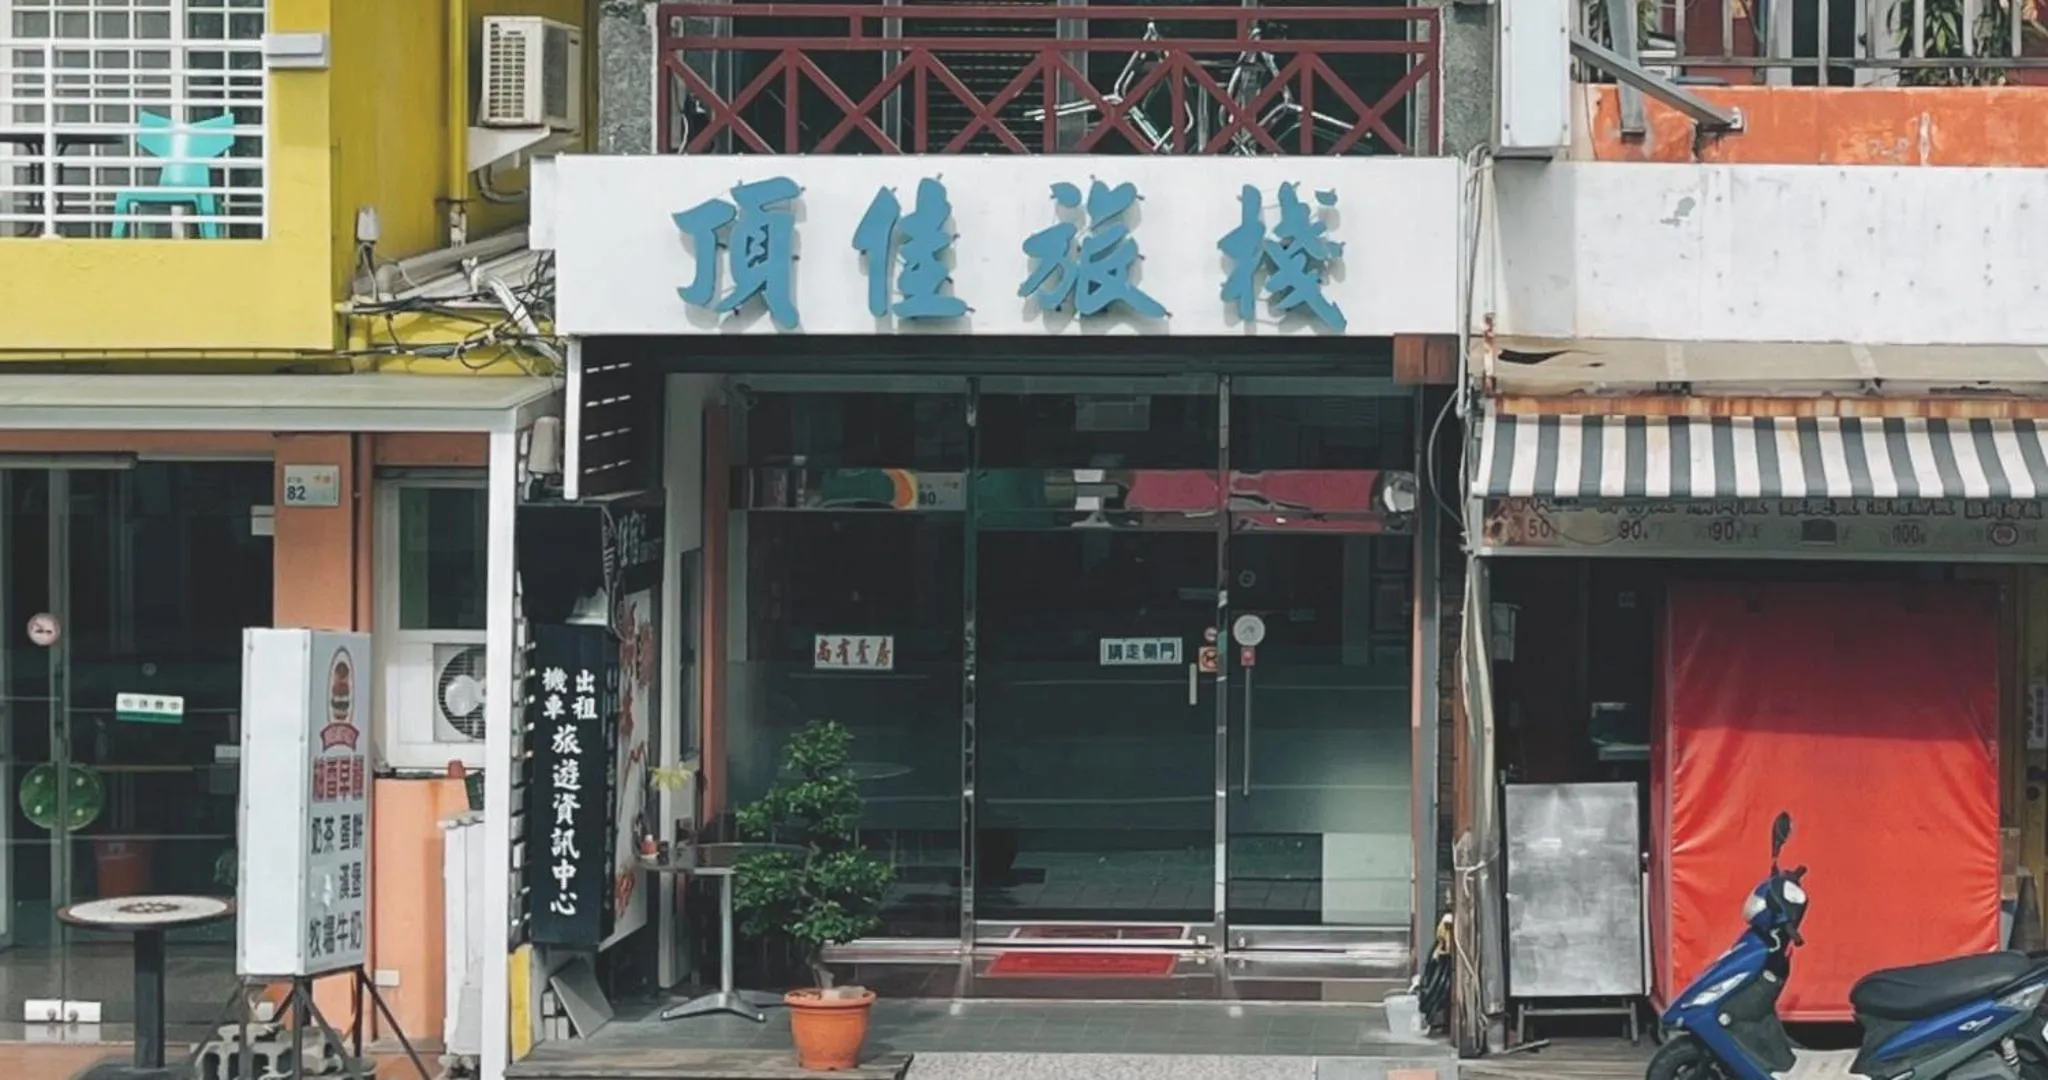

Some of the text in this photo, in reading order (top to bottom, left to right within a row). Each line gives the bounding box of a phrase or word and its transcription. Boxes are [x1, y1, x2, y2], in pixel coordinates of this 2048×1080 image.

[672, 176, 1347, 331] 頂佳旅棧
[287, 485, 306, 501] 82
[542, 667, 568, 720] 機車
[571, 669, 598, 720] 出租
[550, 723, 583, 916] 旅遊資訊中心
